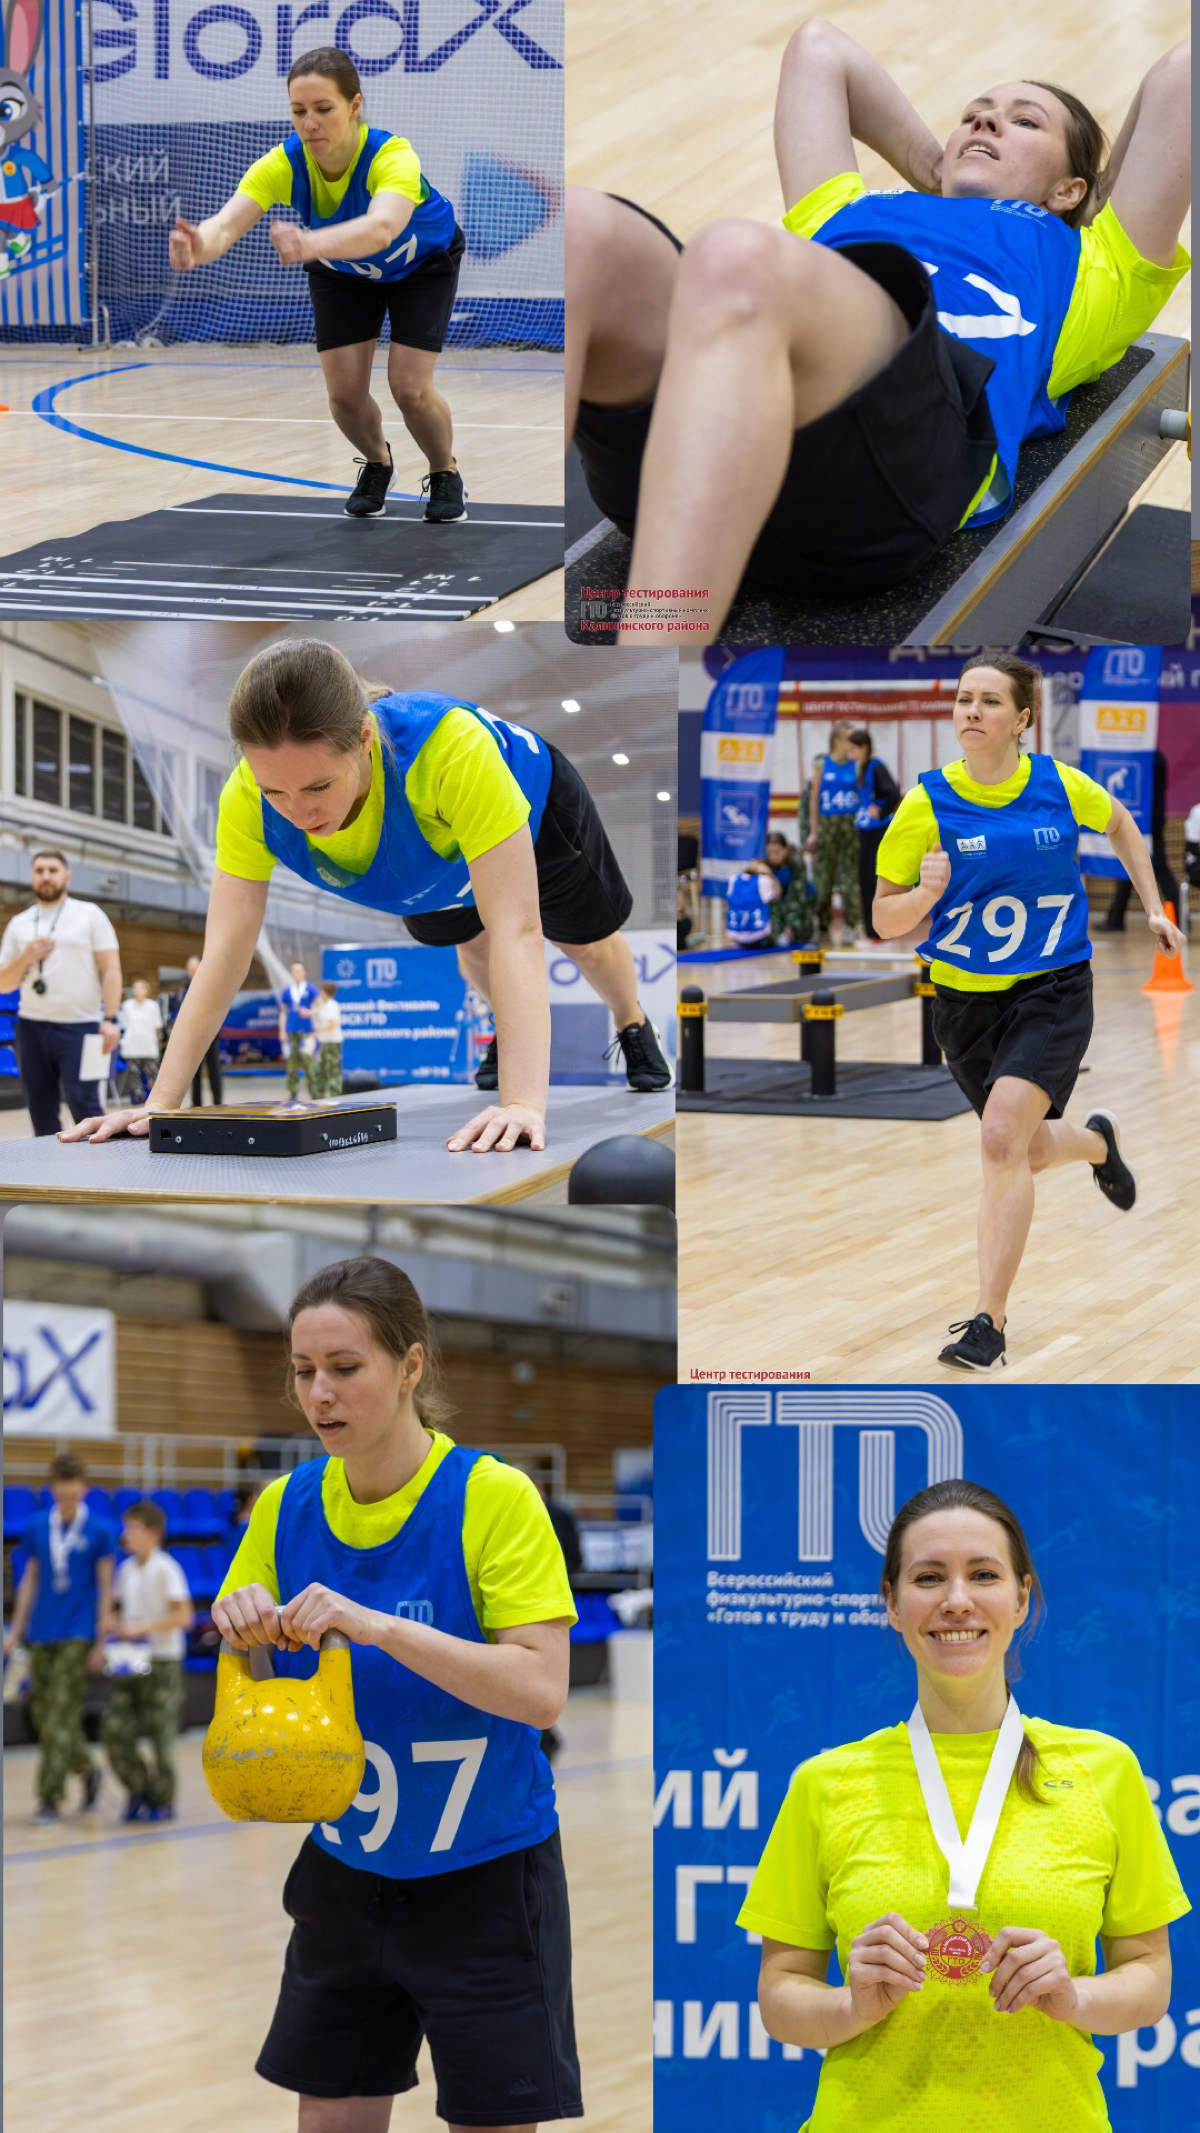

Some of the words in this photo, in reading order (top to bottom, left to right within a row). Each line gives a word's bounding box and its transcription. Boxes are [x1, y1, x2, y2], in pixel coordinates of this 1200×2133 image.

[1033, 828, 1061, 845] ГТО
[936, 894, 1075, 963] 297
[707, 1391, 963, 1562] ГТО
[707, 1571, 834, 1590] Всероссийский
[707, 1608, 763, 1625] «Готов
[766, 1612, 776, 1624] к
[780, 1611, 830, 1629] труду
[833, 1612, 845, 1624] и
[848, 1609, 889, 1630] обор
[320, 1736, 488, 1852] 97
